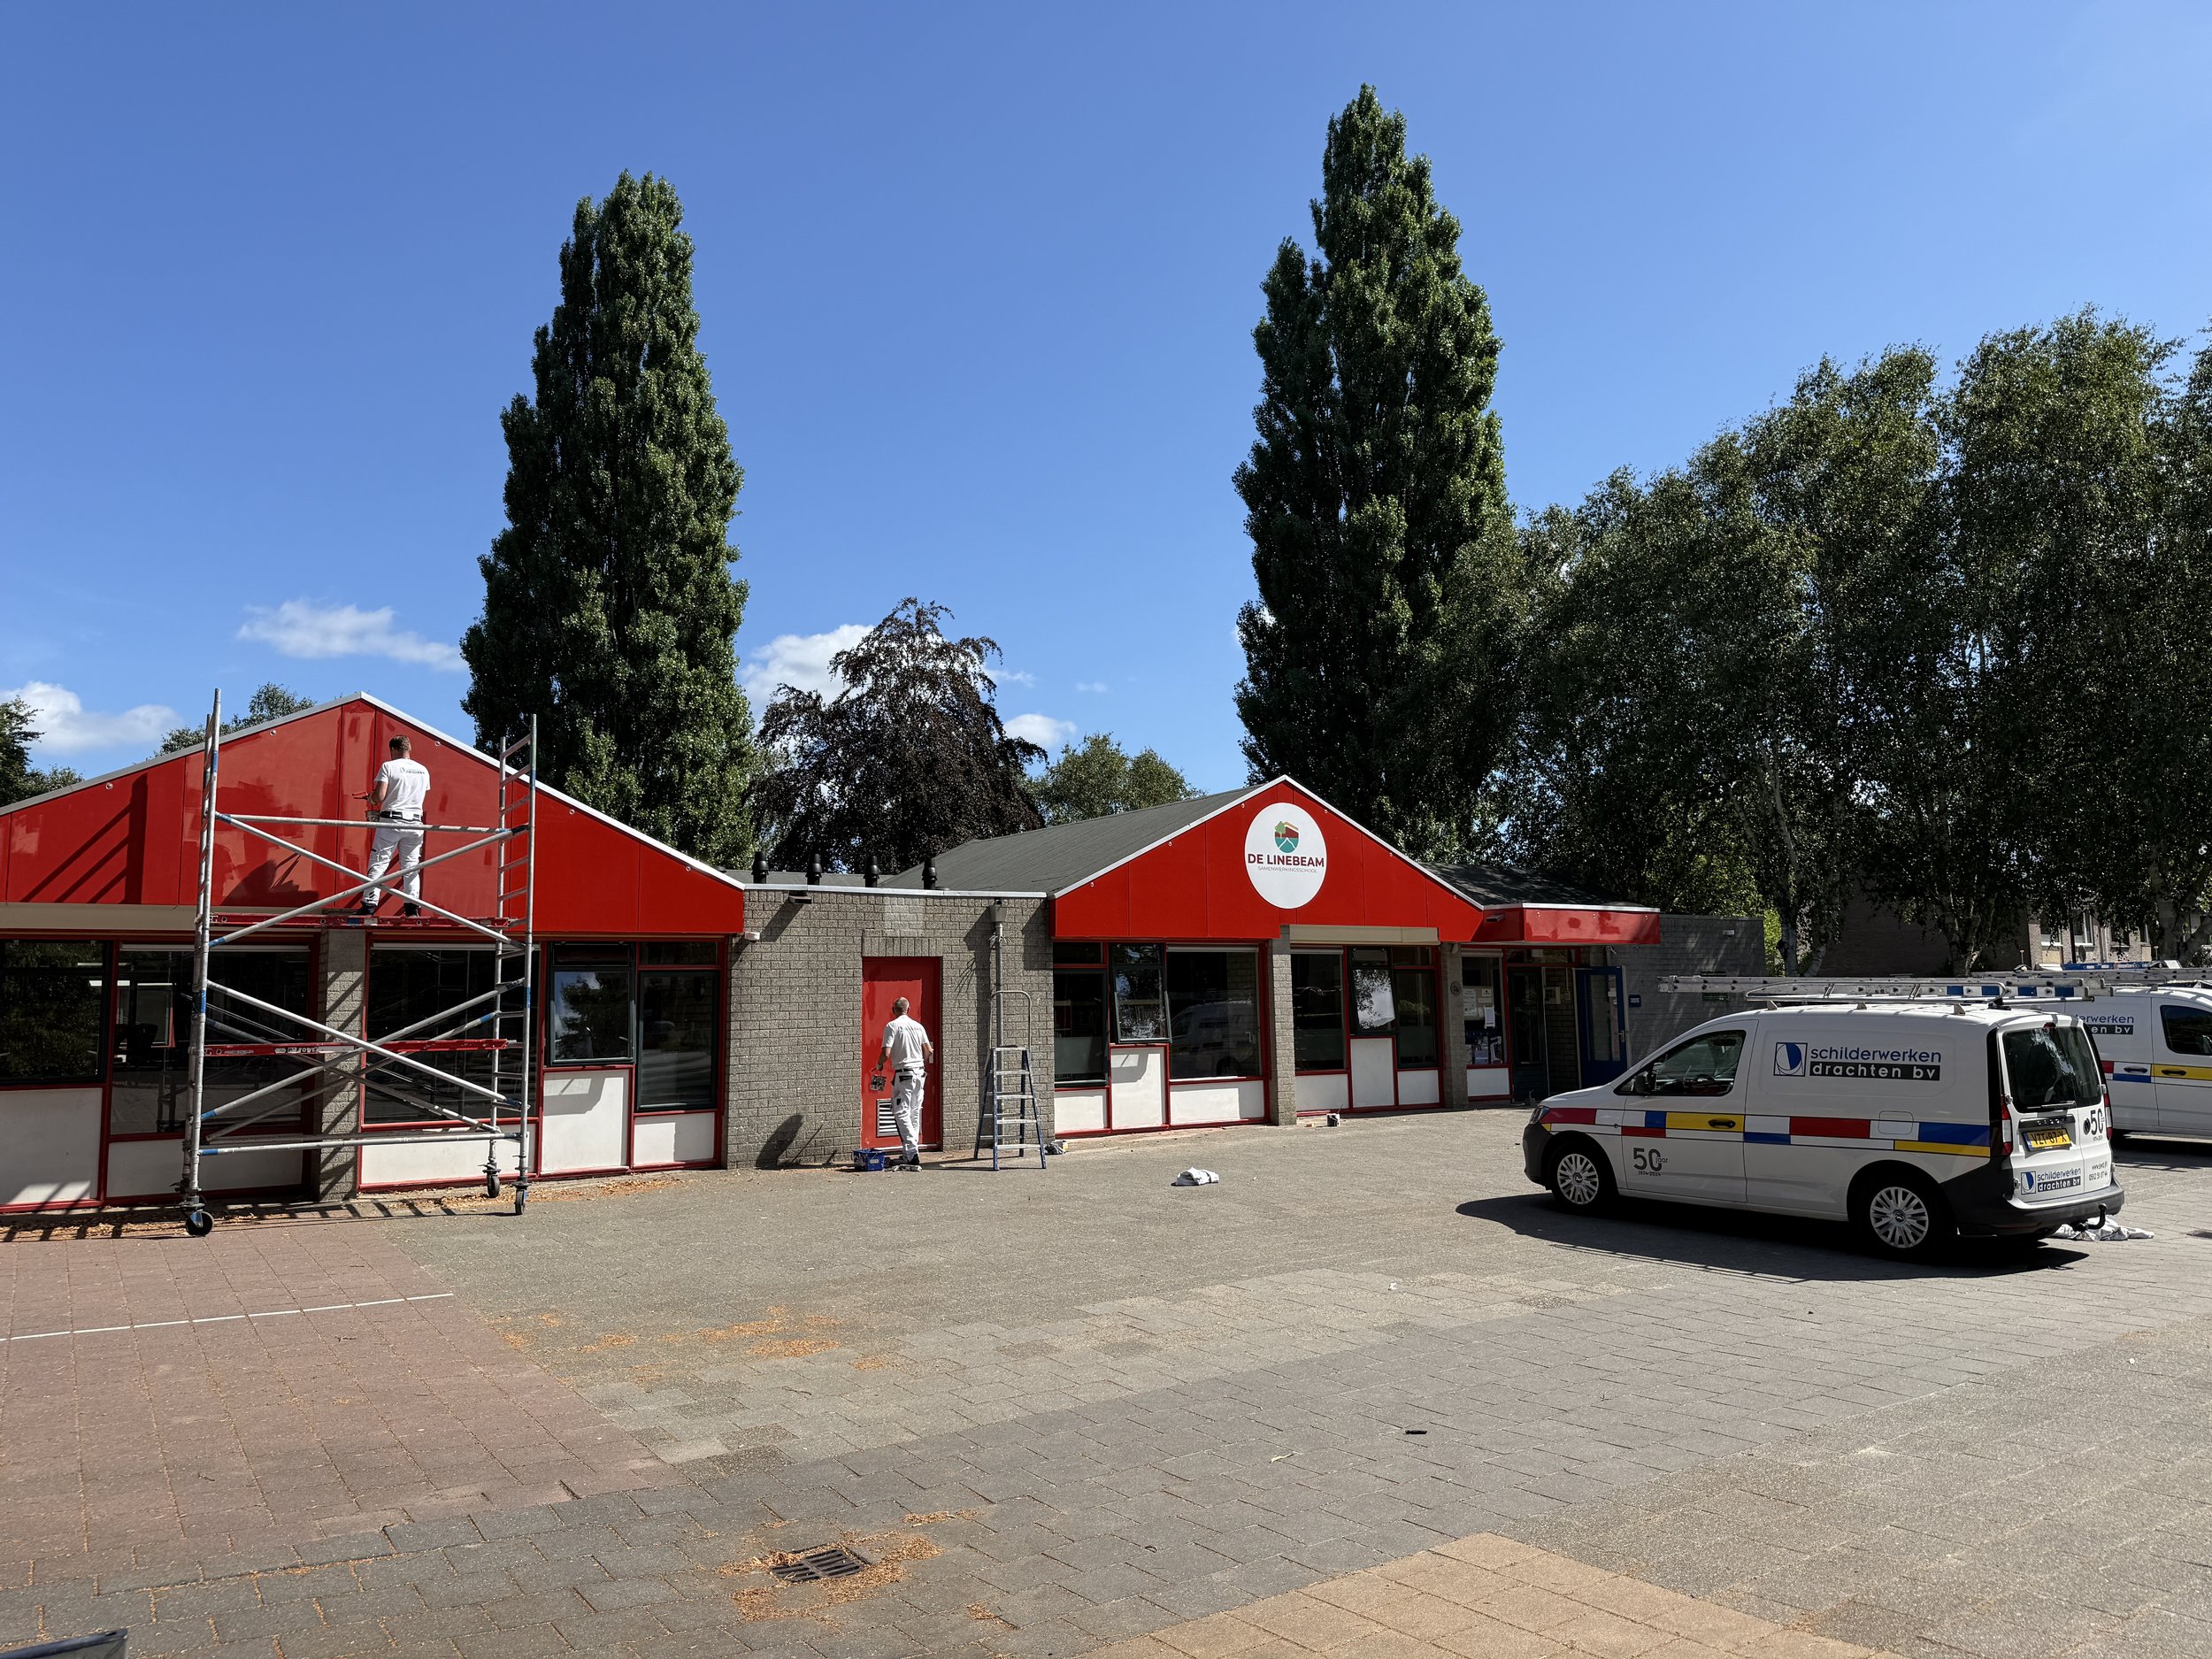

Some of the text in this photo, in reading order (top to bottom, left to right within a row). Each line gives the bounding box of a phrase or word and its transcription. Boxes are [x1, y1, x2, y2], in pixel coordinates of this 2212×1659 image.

[1248, 854, 1325, 867] DE LINEBEAM
[2115, 1025, 2131, 1034] bv
[1810, 1047, 1941, 1063] schilderwerken
[1812, 1063, 1936, 1079] drachten bv
[2090, 1108, 2104, 1136] 50
[2031, 1130, 2067, 1145] VZT-87-X
[1633, 1148, 1662, 1171] 50
[2037, 1168, 2081, 1181] schilderwerken
[2039, 1179, 2071, 1192] drachten
